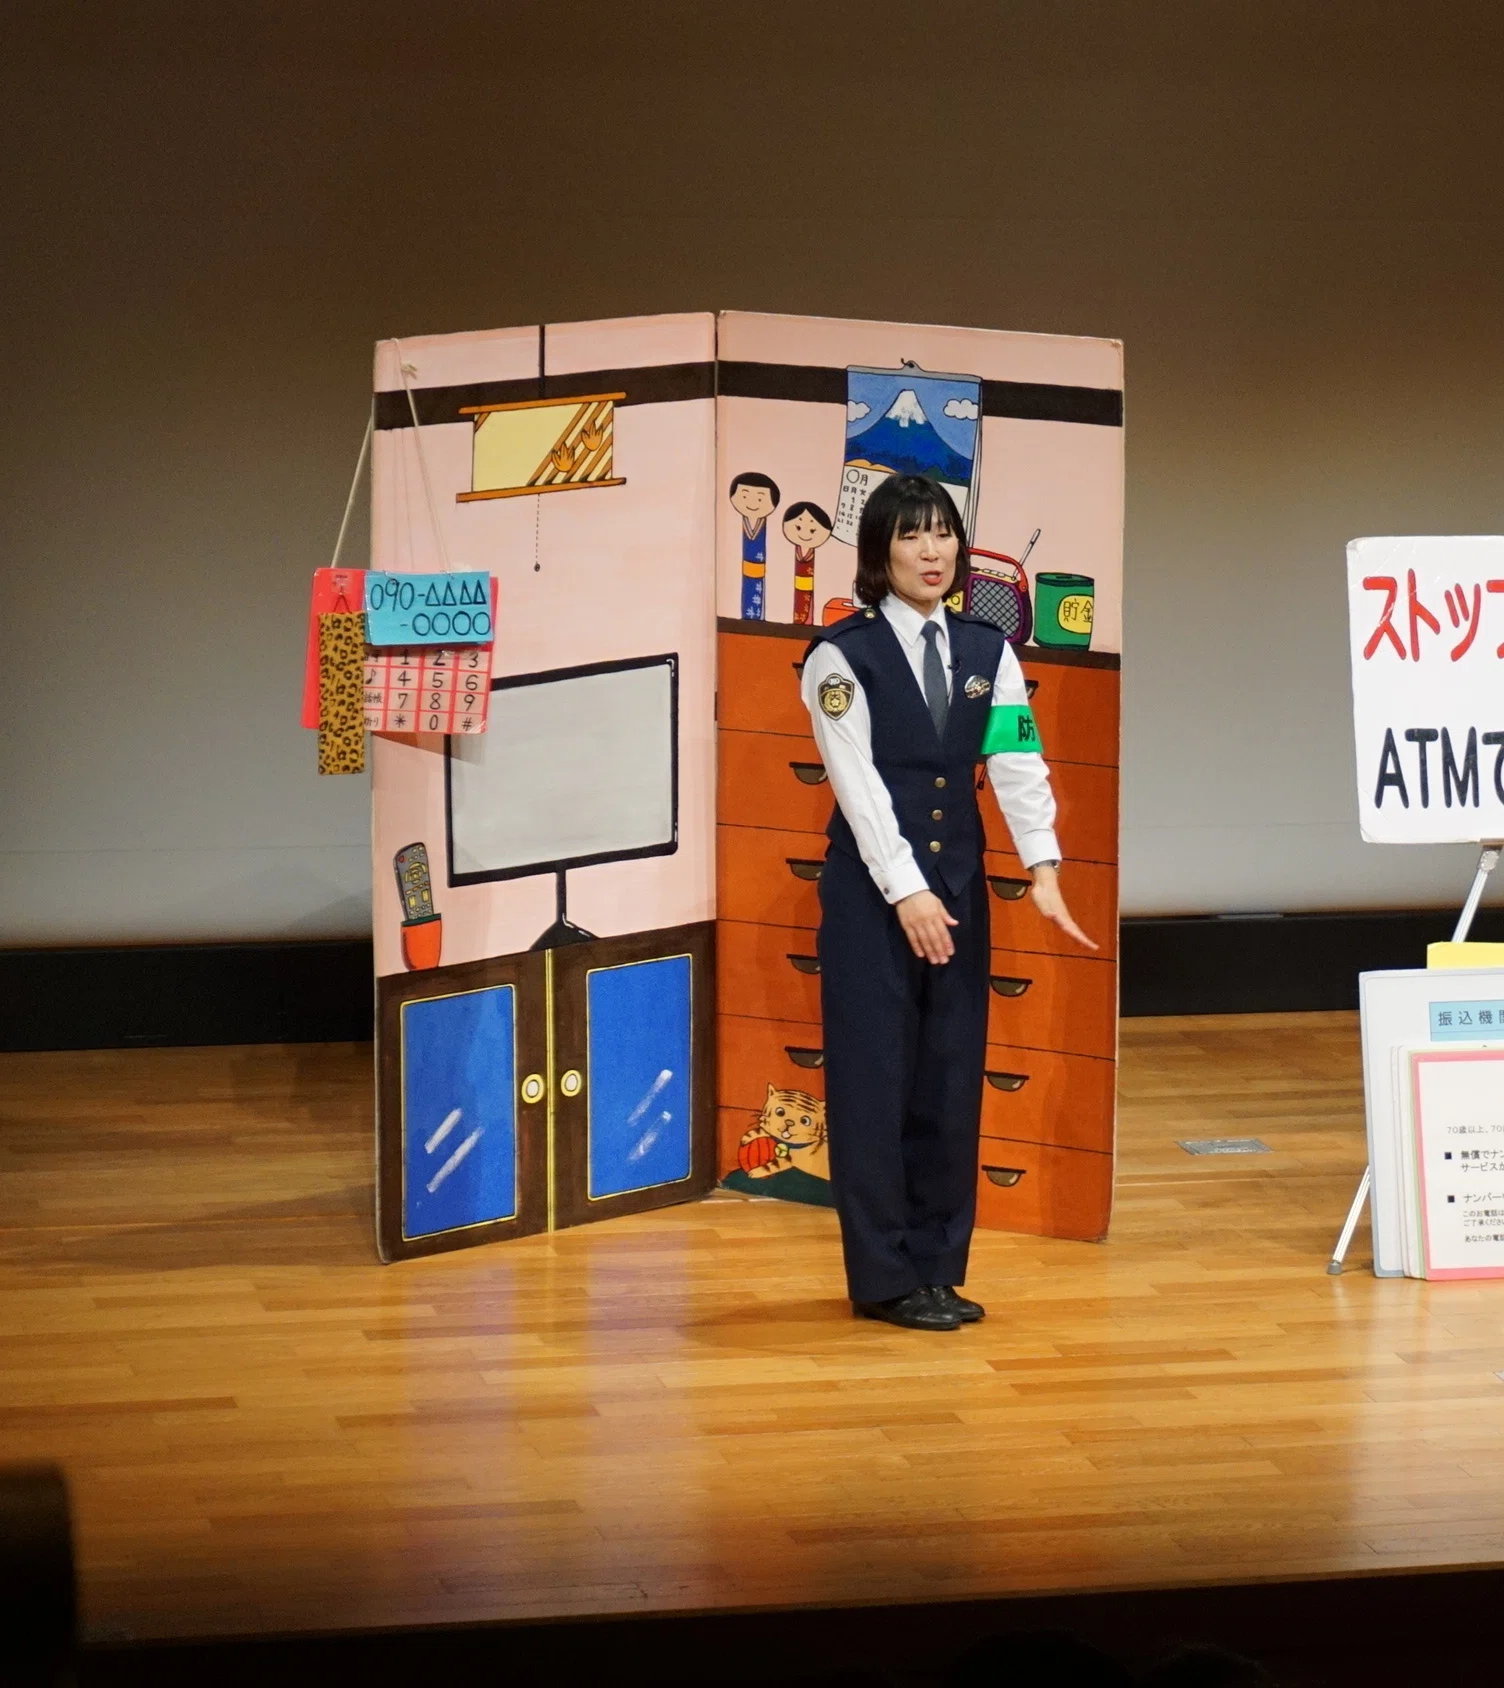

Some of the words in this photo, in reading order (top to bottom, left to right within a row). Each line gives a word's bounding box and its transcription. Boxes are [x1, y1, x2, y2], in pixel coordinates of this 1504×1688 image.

[1063, 597, 1093, 623] 貯金
[400, 649, 410, 665] 1
[468, 651, 479, 668] 3
[397, 670, 412, 687] 4
[432, 672, 444, 688] 5
[465, 674, 479, 691] 6
[397, 693, 408, 709] 7
[429, 692, 441, 710] 8
[463, 694, 475, 711] 9
